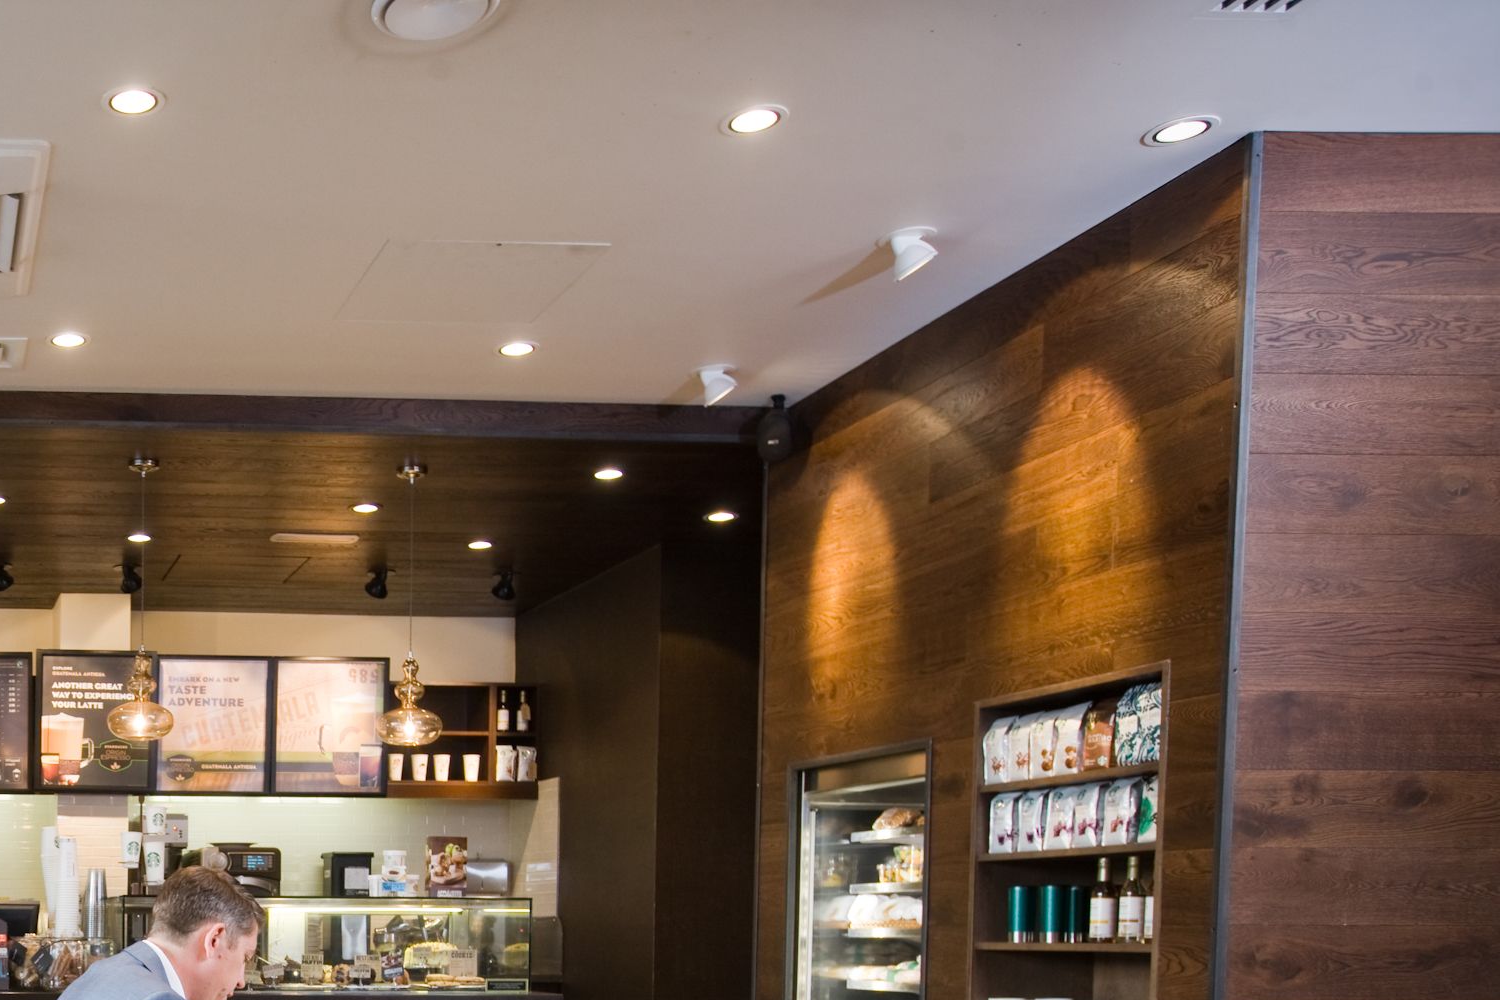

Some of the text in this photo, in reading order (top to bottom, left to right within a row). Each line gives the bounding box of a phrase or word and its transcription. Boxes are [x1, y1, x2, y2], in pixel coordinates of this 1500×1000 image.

[52, 681, 93, 689] ANOTHER
[168, 686, 206, 694] TASTE
[168, 698, 244, 707] ADVENTURE
